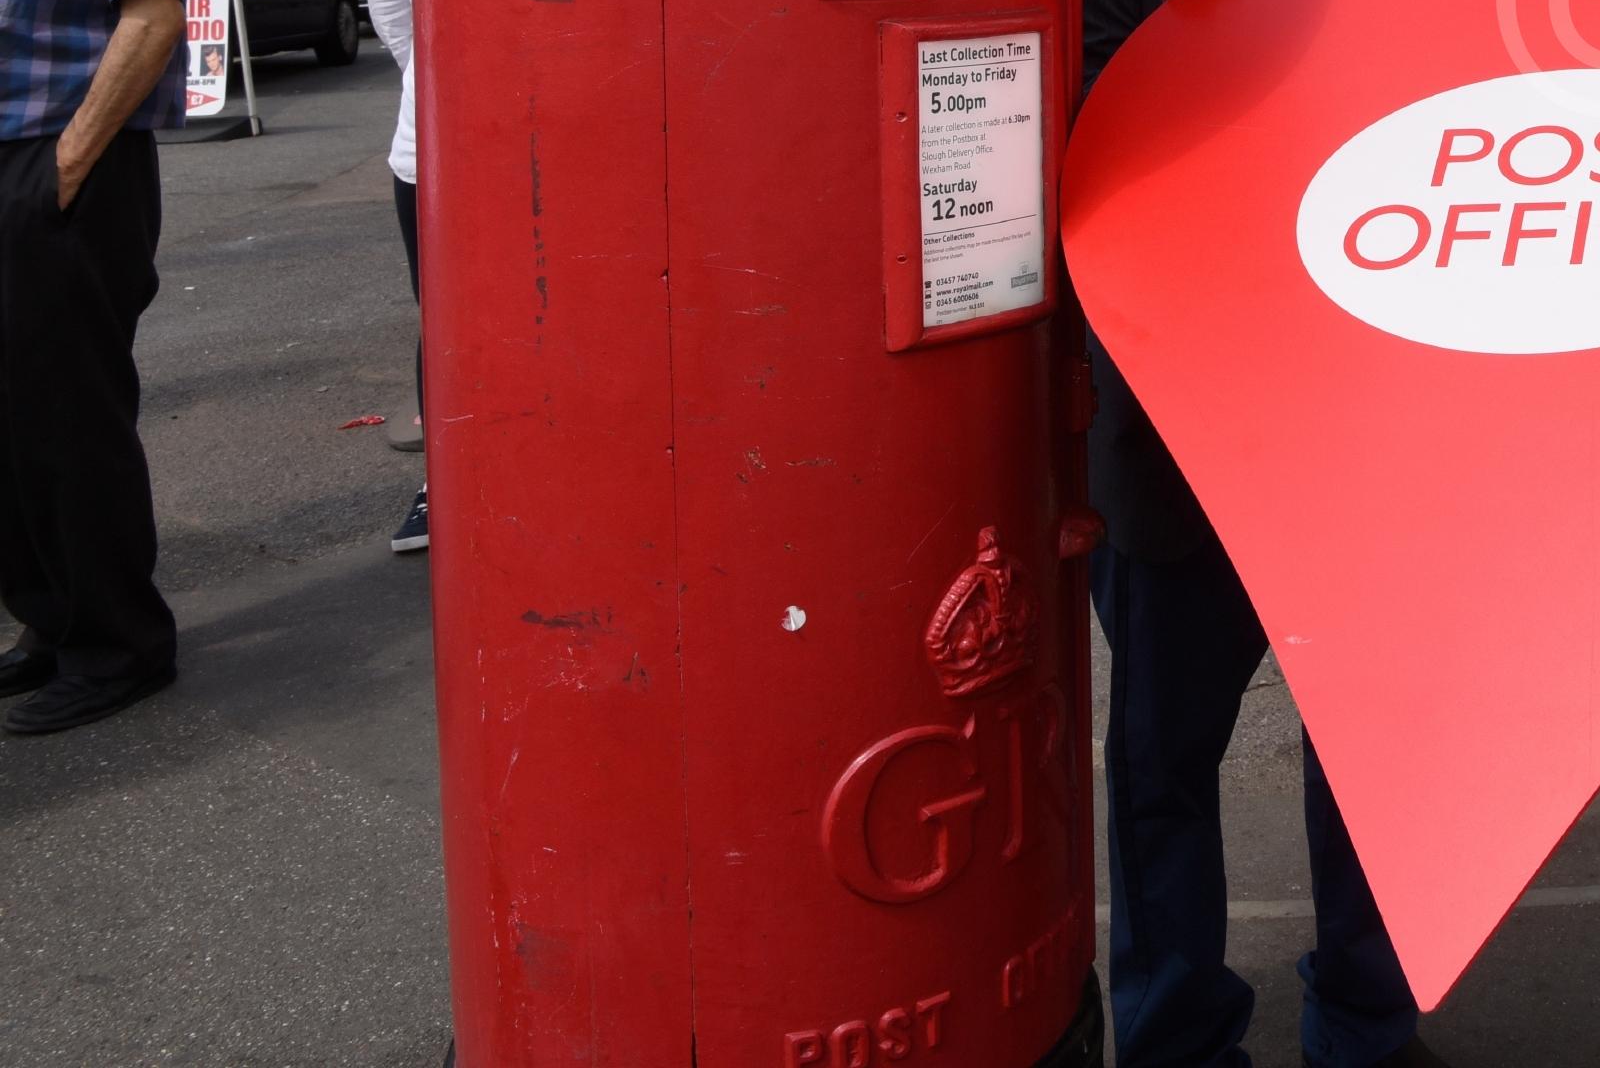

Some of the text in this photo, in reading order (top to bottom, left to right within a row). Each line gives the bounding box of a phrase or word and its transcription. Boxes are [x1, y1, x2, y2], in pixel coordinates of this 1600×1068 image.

[922, 42, 1031, 64] Last Collection Time
[922, 67, 1017, 87] Monday to Friday
[931, 92, 987, 114] 5.00pm
[921, 114, 1031, 134] A later collection is made at 6.30pm
[921, 133, 986, 148] from the Postbox at
[921, 151, 947, 162] Slough
[947, 147, 974, 159] Delivery
[921, 161, 971, 175] Wexham Road
[923, 178, 978, 197] Saturday
[932, 197, 993, 221] 12 noon
[924, 232, 975, 246] Other Collections
[936, 276, 956, 287] 03457
[936, 280, 994, 297] www.royalmail.com
[936, 297, 952, 308] 0345
[784, 991, 951, 1068] POST
